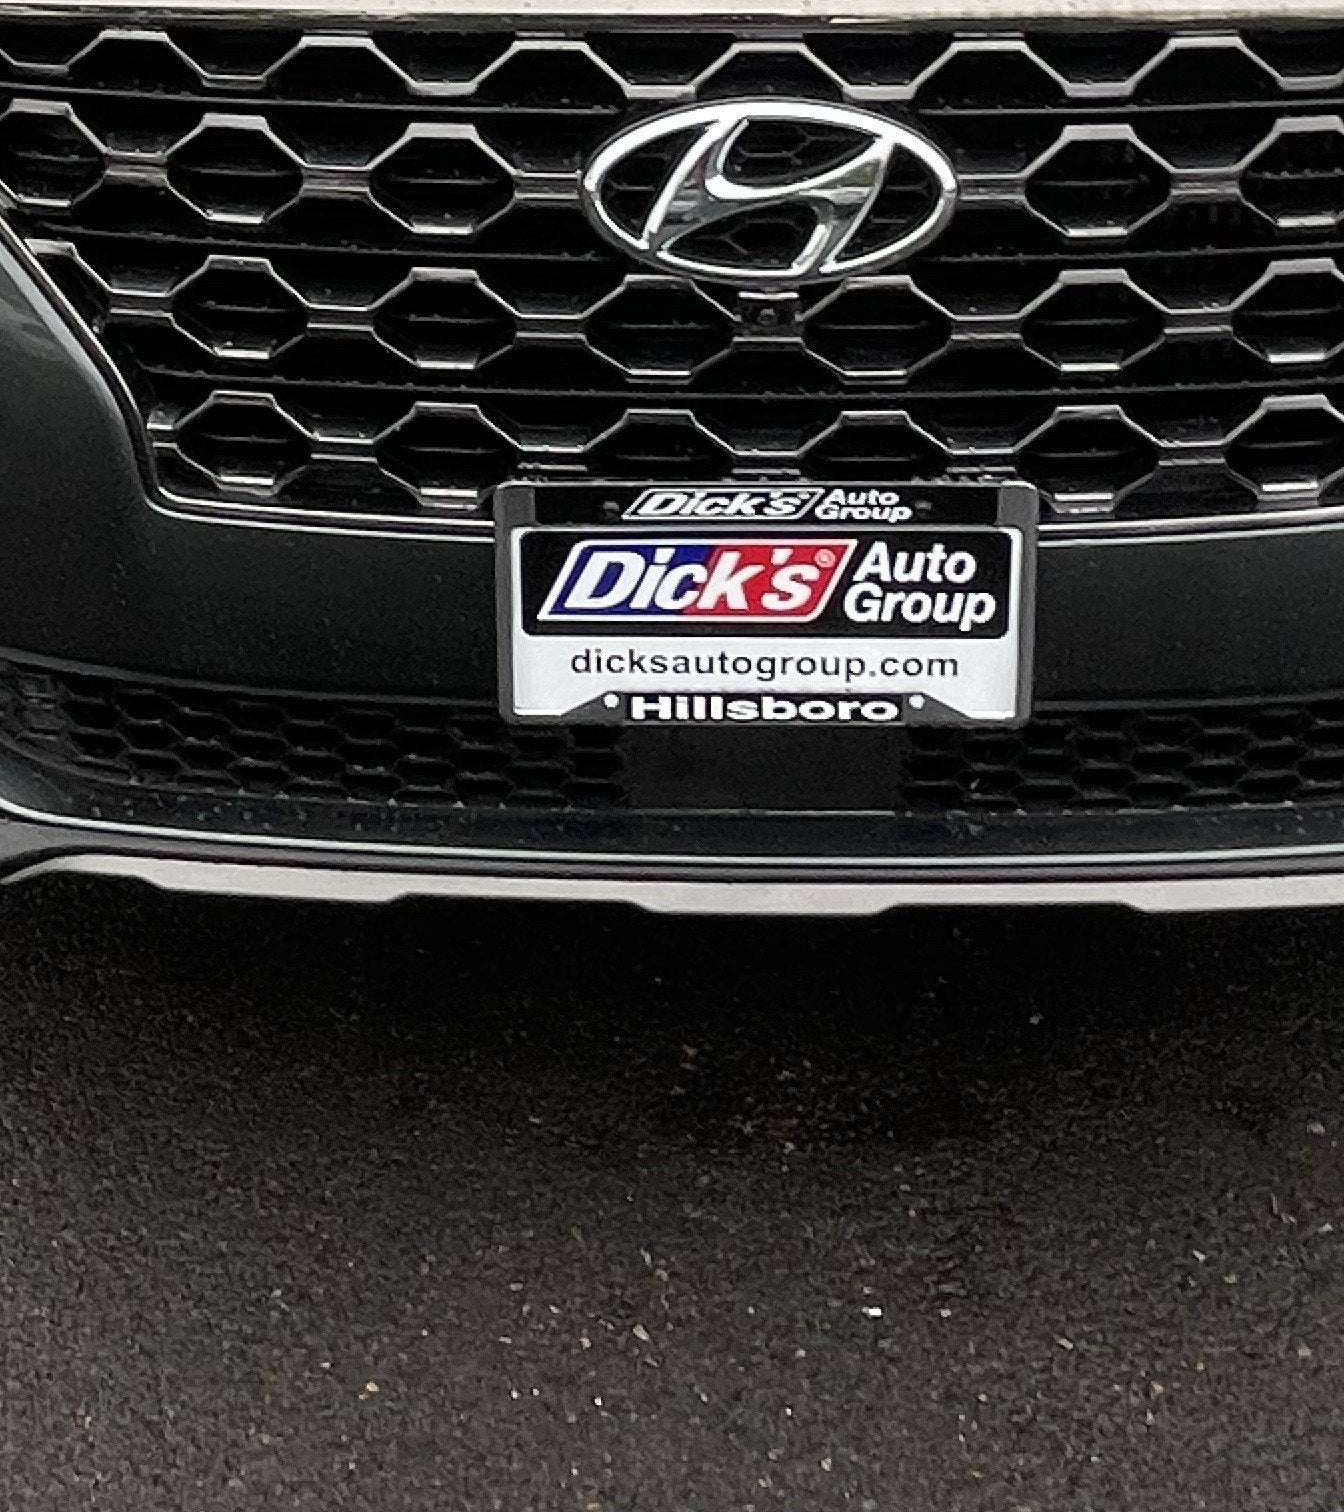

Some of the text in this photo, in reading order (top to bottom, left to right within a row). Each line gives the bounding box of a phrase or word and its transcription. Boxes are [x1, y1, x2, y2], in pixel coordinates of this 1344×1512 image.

[813, 504, 913, 524] Group
[825, 488, 900, 507] Auto
[852, 540, 978, 584] Auto
[562, 547, 822, 613] Dick's
[842, 581, 997, 632] Group
[569, 648, 960, 683] dicksautogroup.com
[630, 695, 900, 722] Hillsboro
